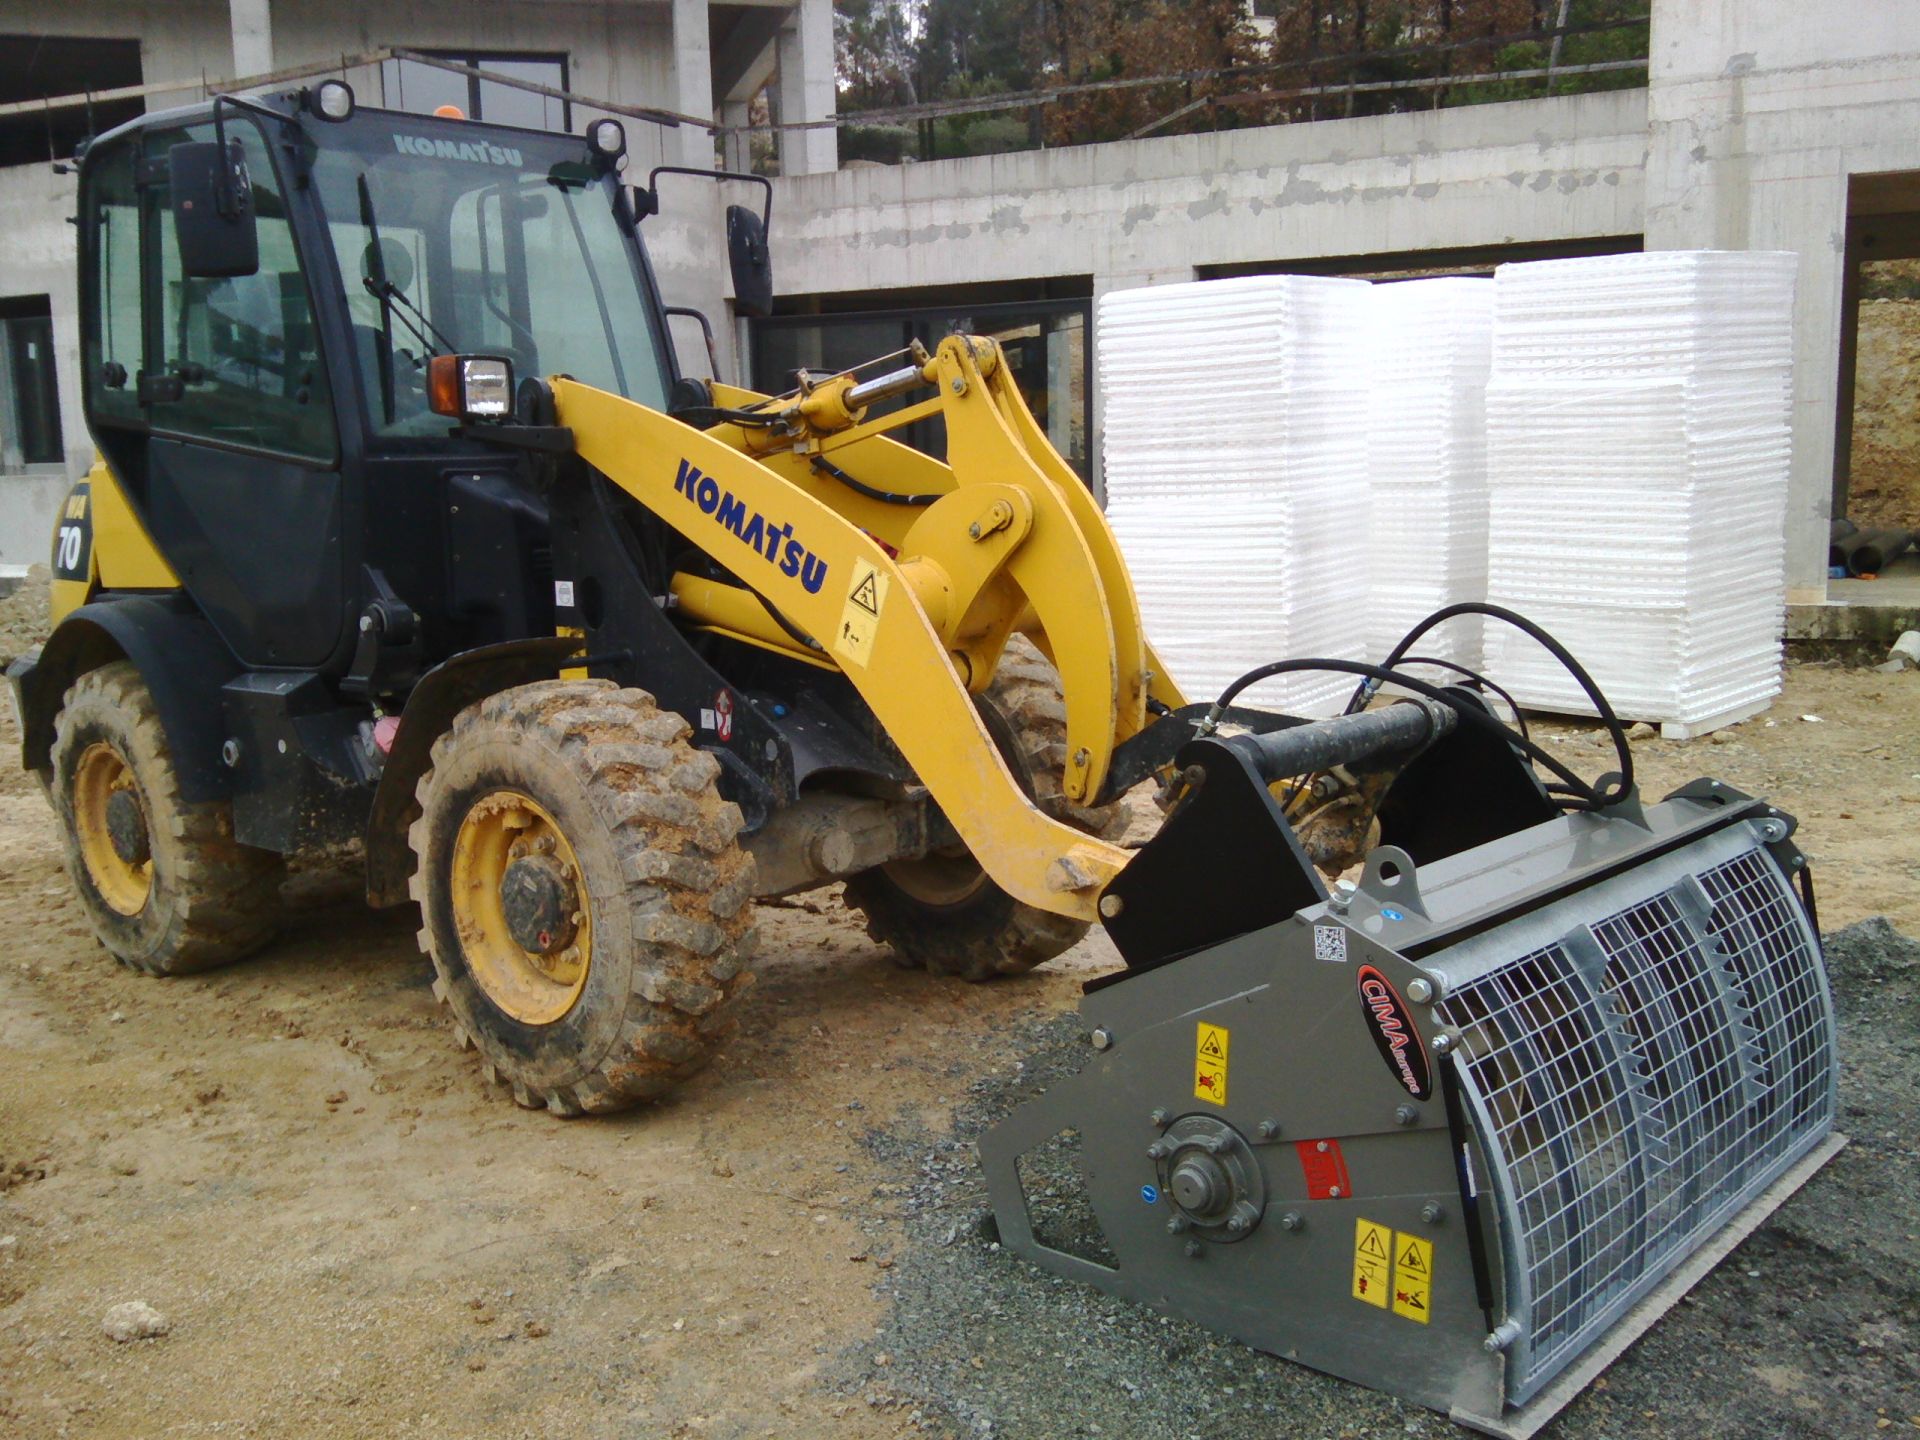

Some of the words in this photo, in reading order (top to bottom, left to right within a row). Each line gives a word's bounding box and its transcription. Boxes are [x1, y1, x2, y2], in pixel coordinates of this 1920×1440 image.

[393, 134, 523, 167] KOMATSU
[674, 457, 828, 594] KOMATSU
[57, 526, 81, 570] 70
